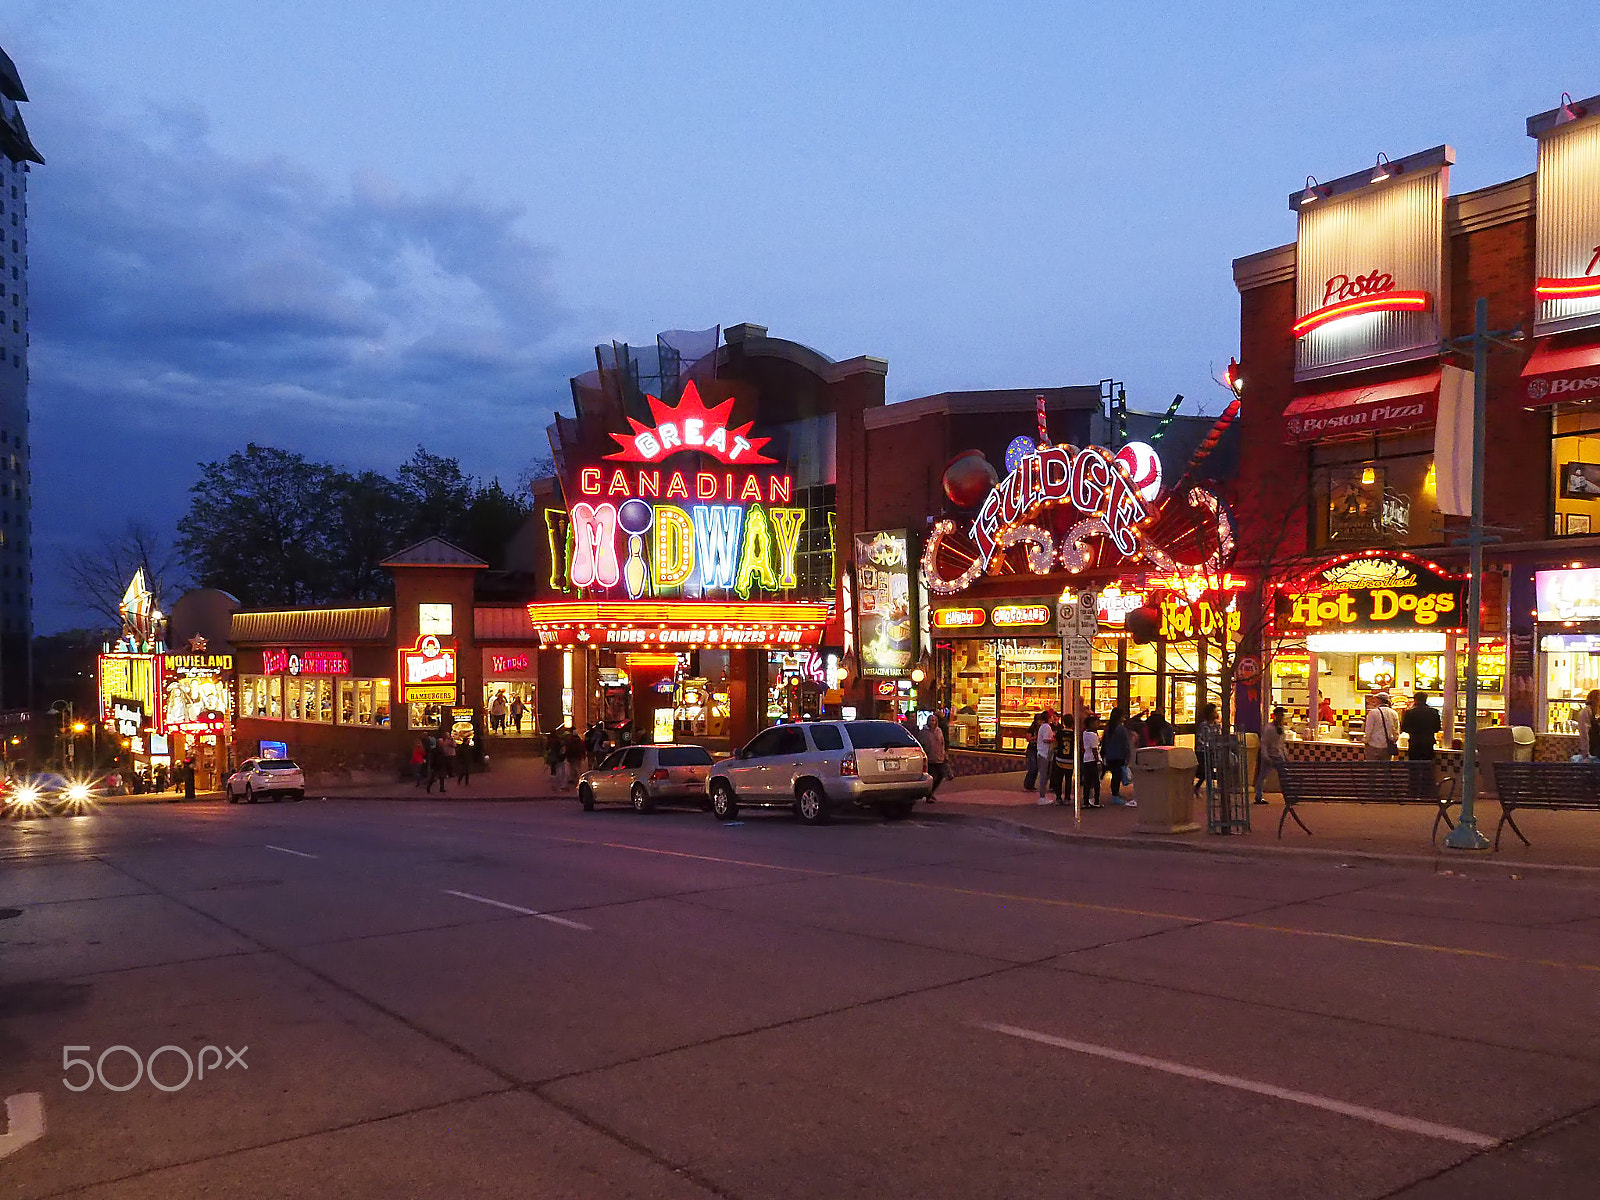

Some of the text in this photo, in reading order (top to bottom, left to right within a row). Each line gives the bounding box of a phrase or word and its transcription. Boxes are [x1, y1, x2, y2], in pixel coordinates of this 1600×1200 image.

[1322, 269, 1396, 306] Pasta
[1550, 376, 1600, 395] Bos
[1303, 412, 1367, 431] Boston
[1370, 402, 1424, 422] Pizza
[634, 418, 752, 460] GREAT
[581, 468, 791, 502] CANADIAN
[968, 447, 1147, 572] FUDGE
[570, 498, 806, 600] MIDWAY
[1289, 589, 1455, 627] Hot Dogs
[606, 630, 802, 643] RIDES GAMES & PRIZES FUN
[164, 655, 233, 670] MOVIELAND
[299, 659, 350, 674] HAMBURGERS
[492, 654, 528, 673] Wendy's
[410, 692, 452, 700] HAMBURGERS
